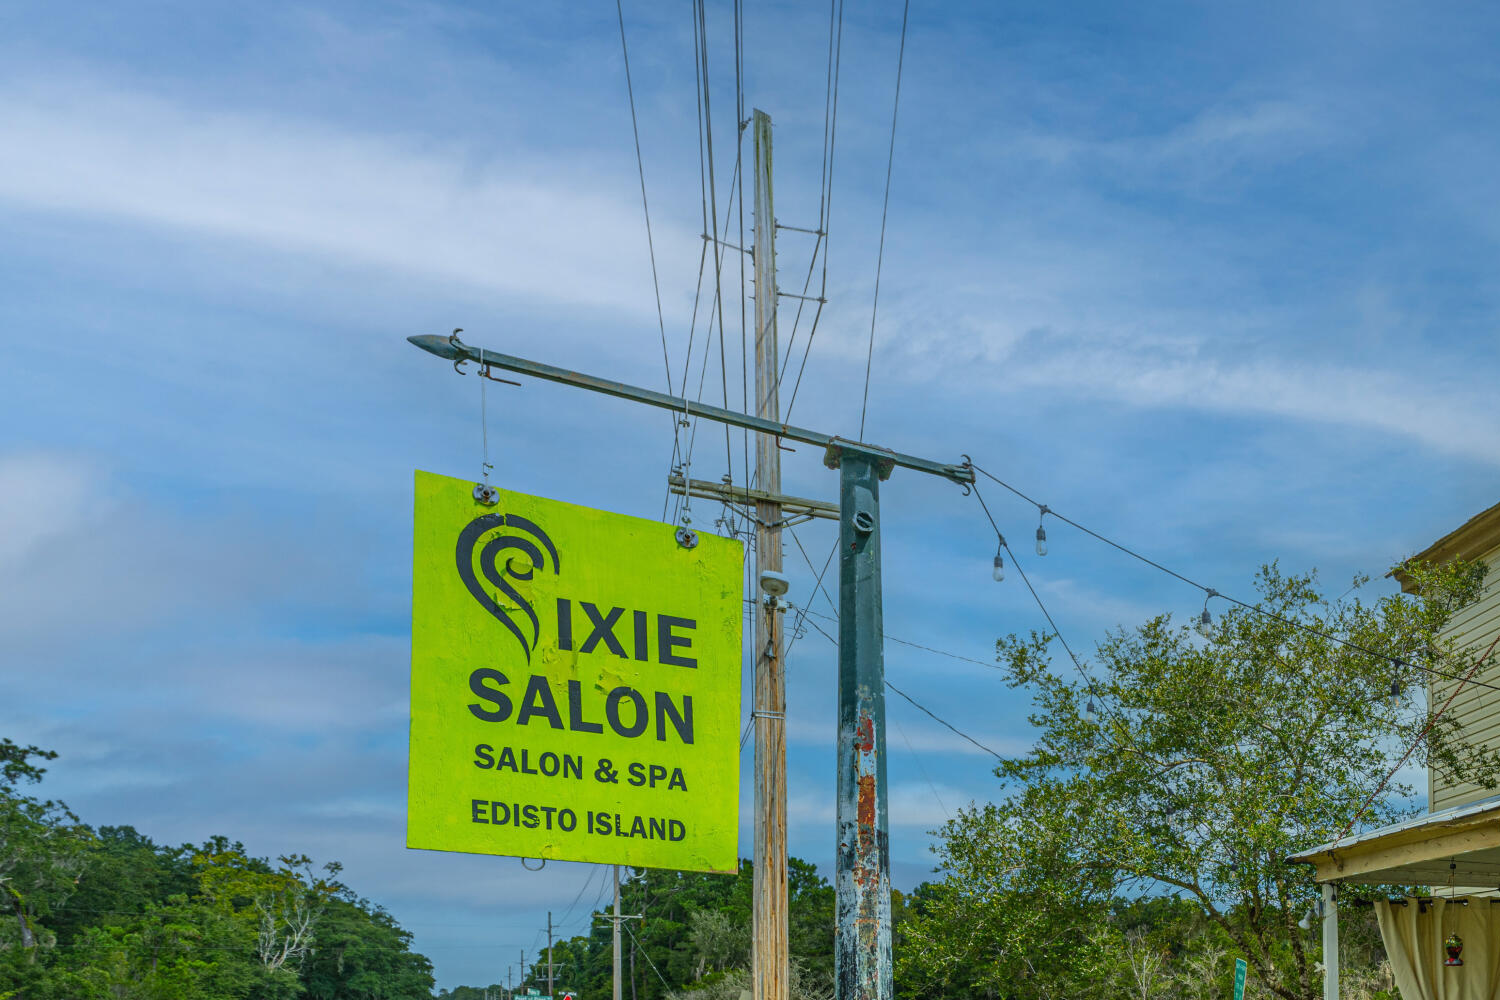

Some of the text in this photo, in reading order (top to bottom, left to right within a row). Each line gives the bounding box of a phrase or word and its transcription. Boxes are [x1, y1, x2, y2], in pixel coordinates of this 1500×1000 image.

[467, 667, 694, 745] SALON
[473, 743, 688, 792] SALON & SPA
[471, 799, 686, 842] EDISTO ISLAND
